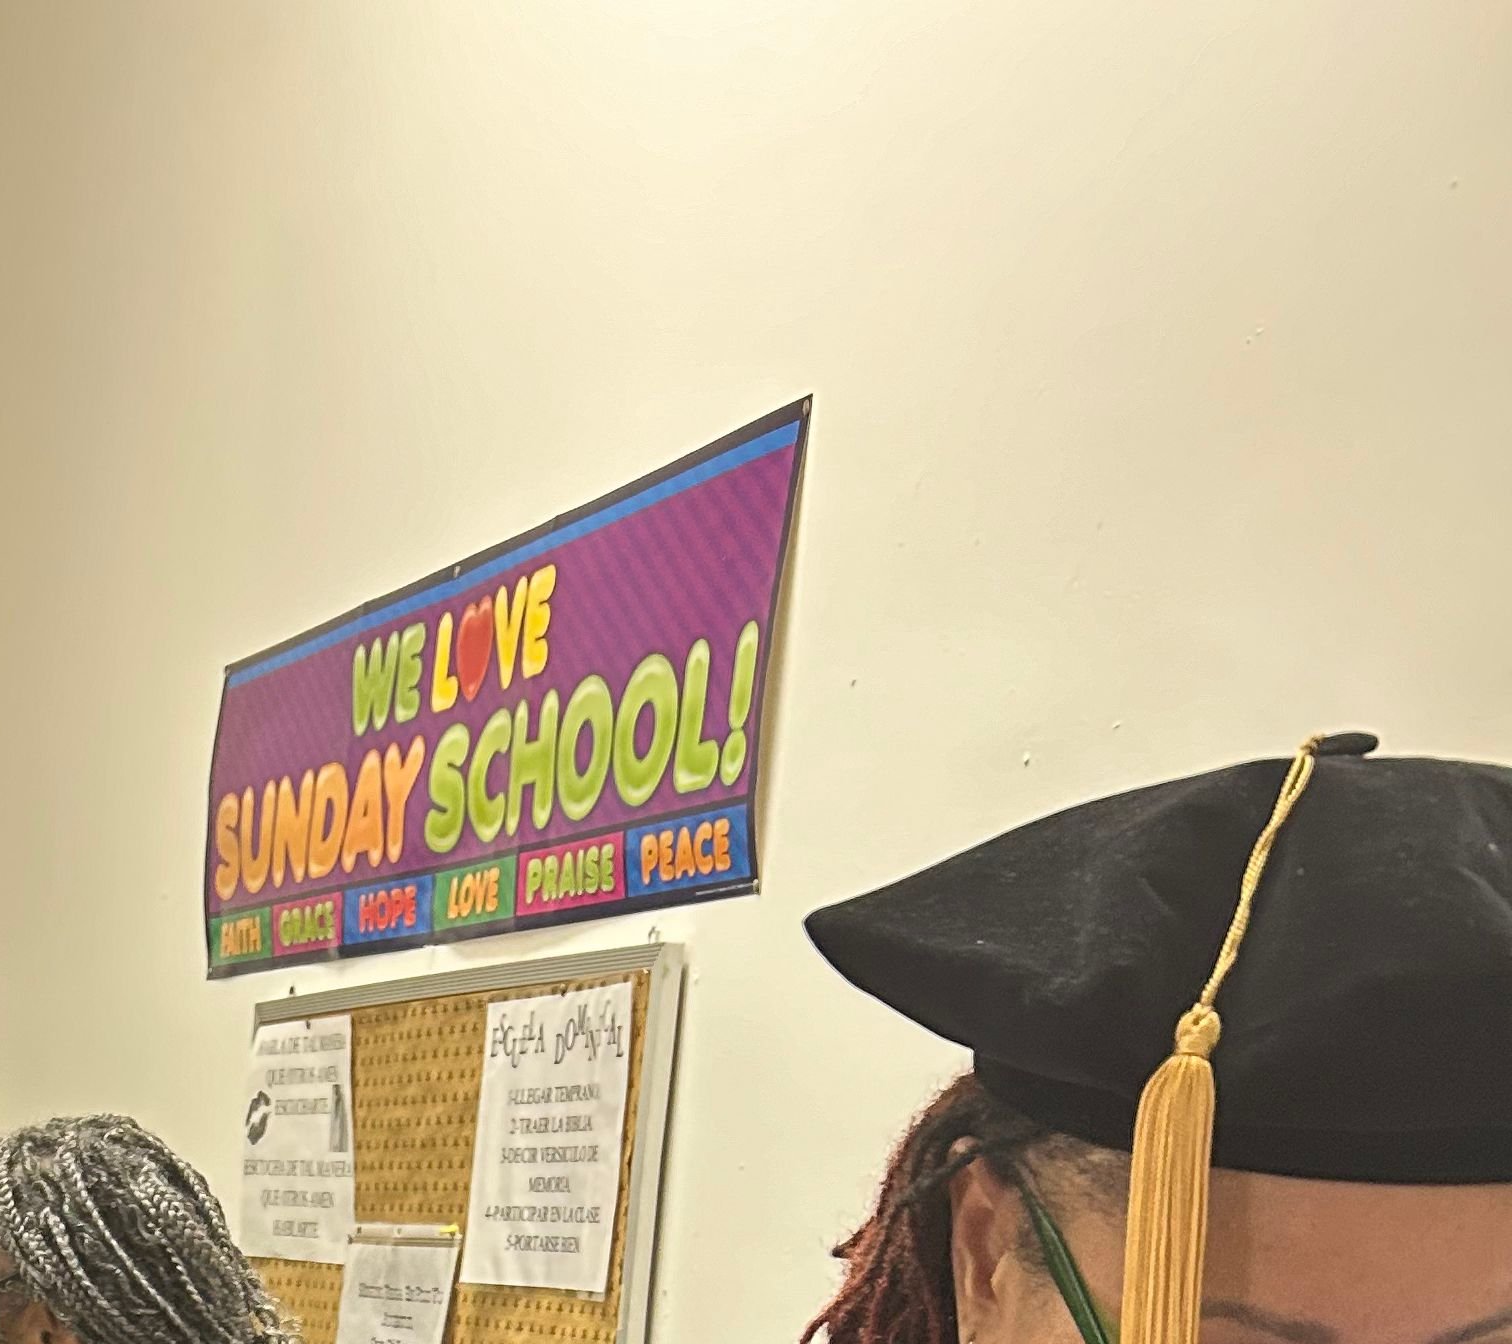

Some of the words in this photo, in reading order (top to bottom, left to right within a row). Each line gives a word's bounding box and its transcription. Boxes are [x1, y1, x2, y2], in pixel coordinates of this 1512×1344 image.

[352, 622, 427, 737] WE
[215, 735, 425, 901] SUNDAY
[424, 620, 760, 855] SCHOOL!
[220, 916, 263, 956] FAITH
[279, 903, 336, 947] GRACE
[358, 886, 417, 934] HOPE
[447, 868, 500, 920] LOVE
[525, 844, 615, 904] PRAISE
[640, 819, 731, 886] PEACE
